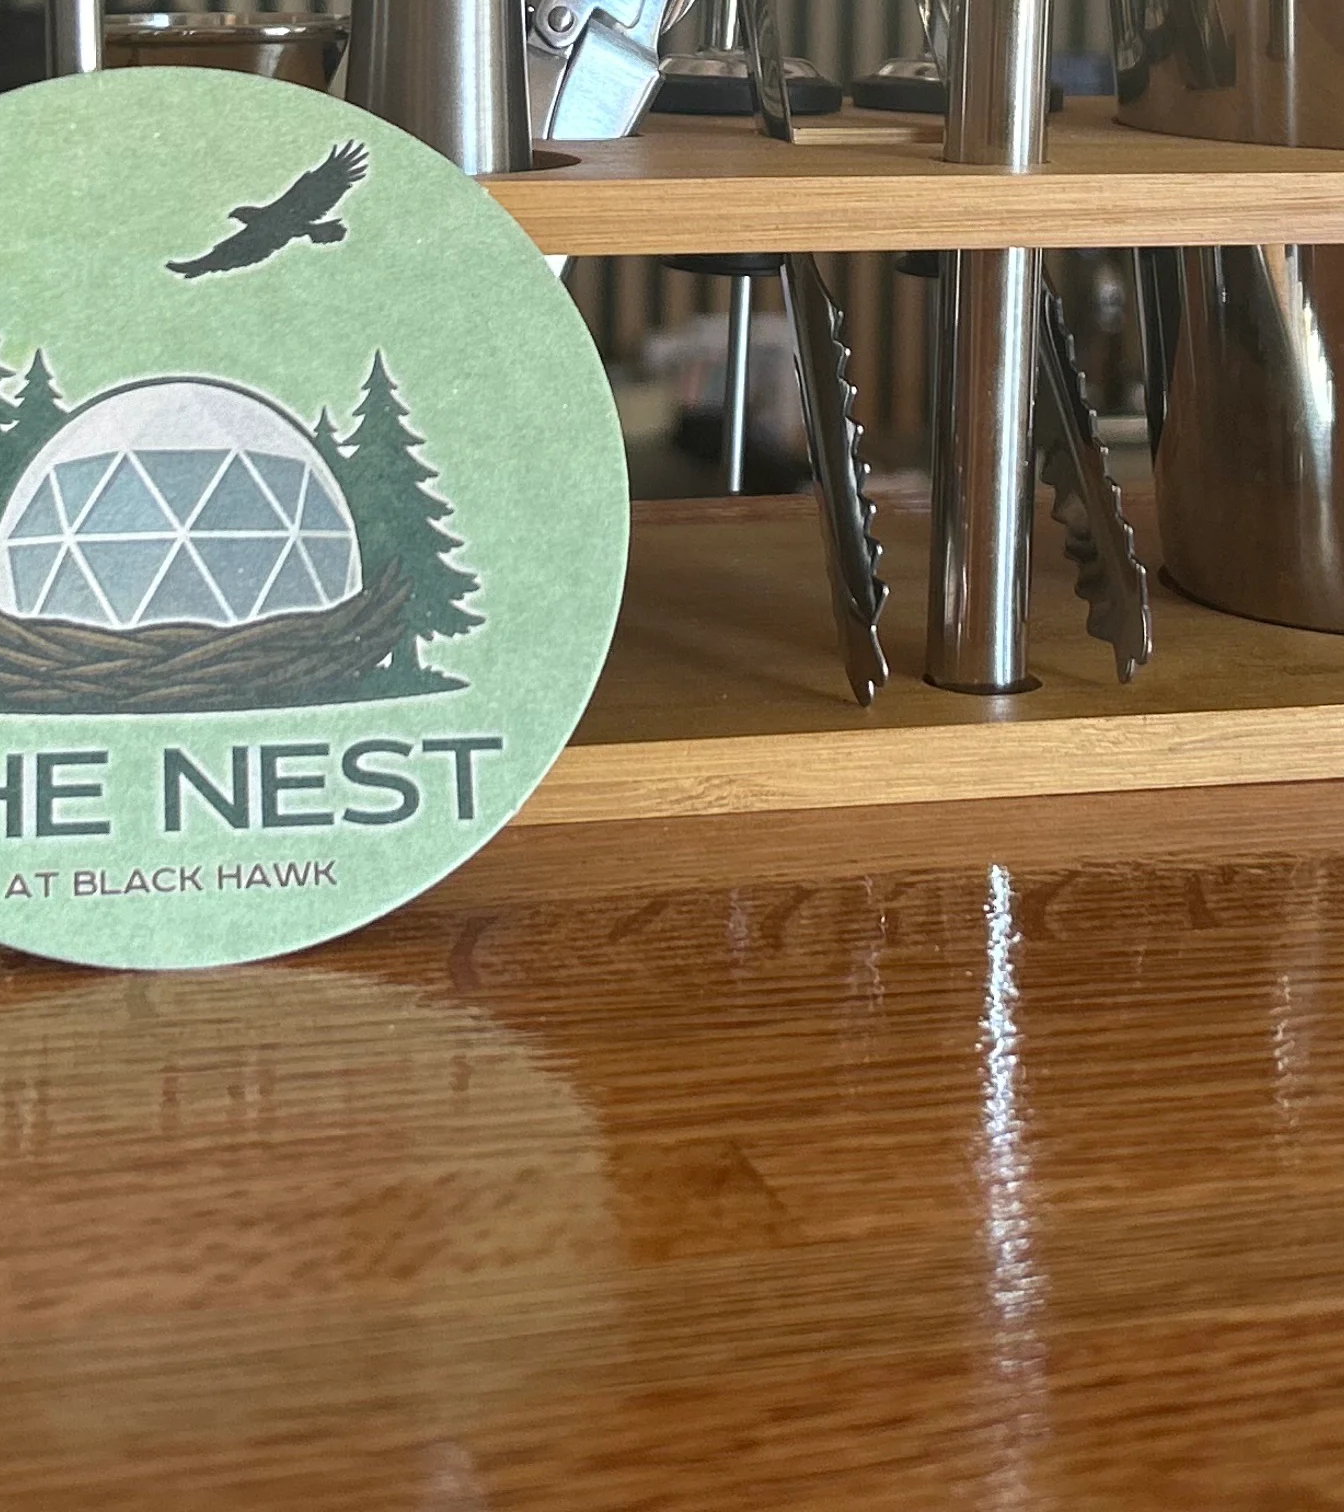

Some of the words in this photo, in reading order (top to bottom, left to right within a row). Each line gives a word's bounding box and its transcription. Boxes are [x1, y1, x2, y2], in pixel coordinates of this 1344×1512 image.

[163, 736, 504, 833] NEST
[4, 871, 57, 899] AT
[73, 864, 202, 897] BLACK
[218, 859, 338, 890] HAWK
